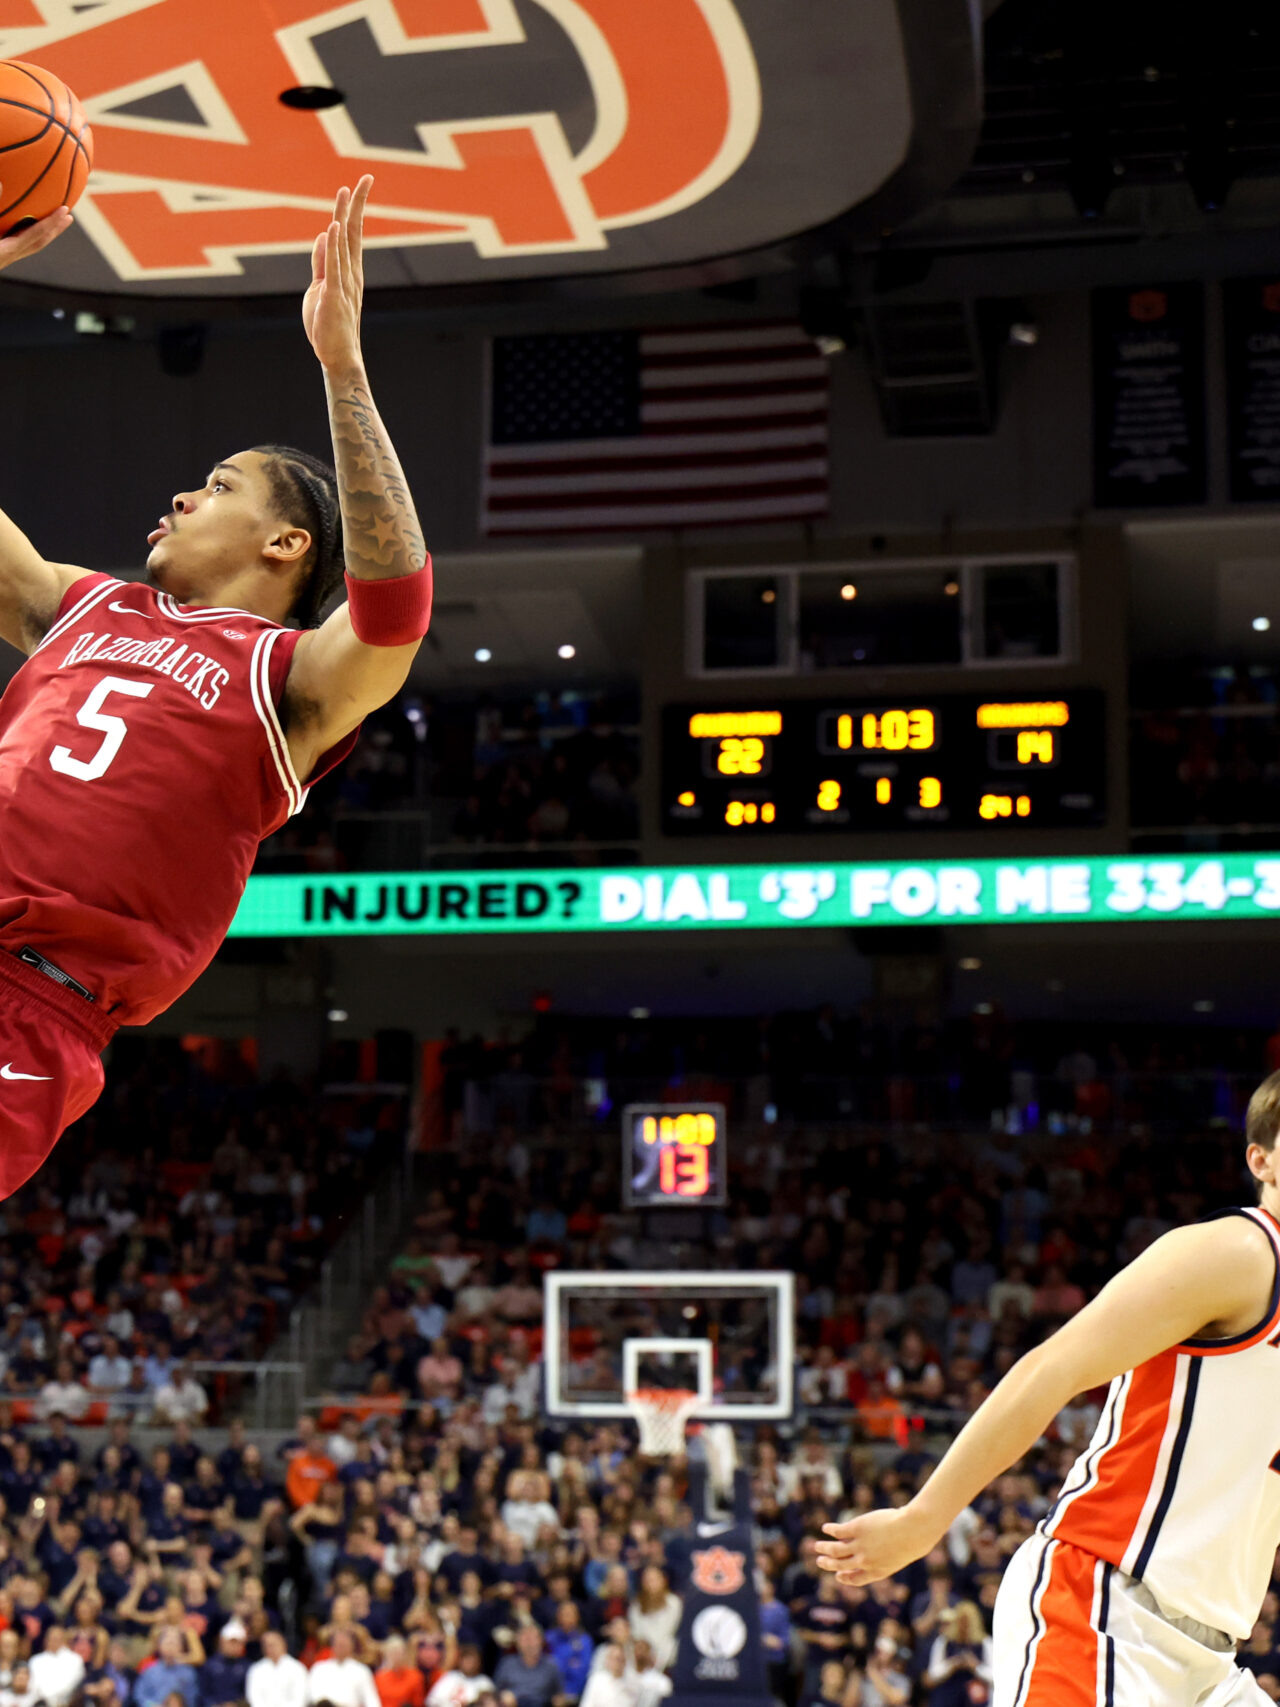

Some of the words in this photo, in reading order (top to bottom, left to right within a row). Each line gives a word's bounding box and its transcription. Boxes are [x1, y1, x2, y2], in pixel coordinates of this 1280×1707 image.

[58, 631, 230, 711] RAZORBACKS
[49, 676, 155, 782] 5
[718, 738, 765, 775] 22
[838, 710, 934, 750] 11:03
[303, 880, 582, 923] INJURED?
[599, 873, 747, 923] DIAL
[850, 868, 982, 918] FOR
[996, 864, 1091, 914] ME
[659, 1143, 710, 1197] 13
